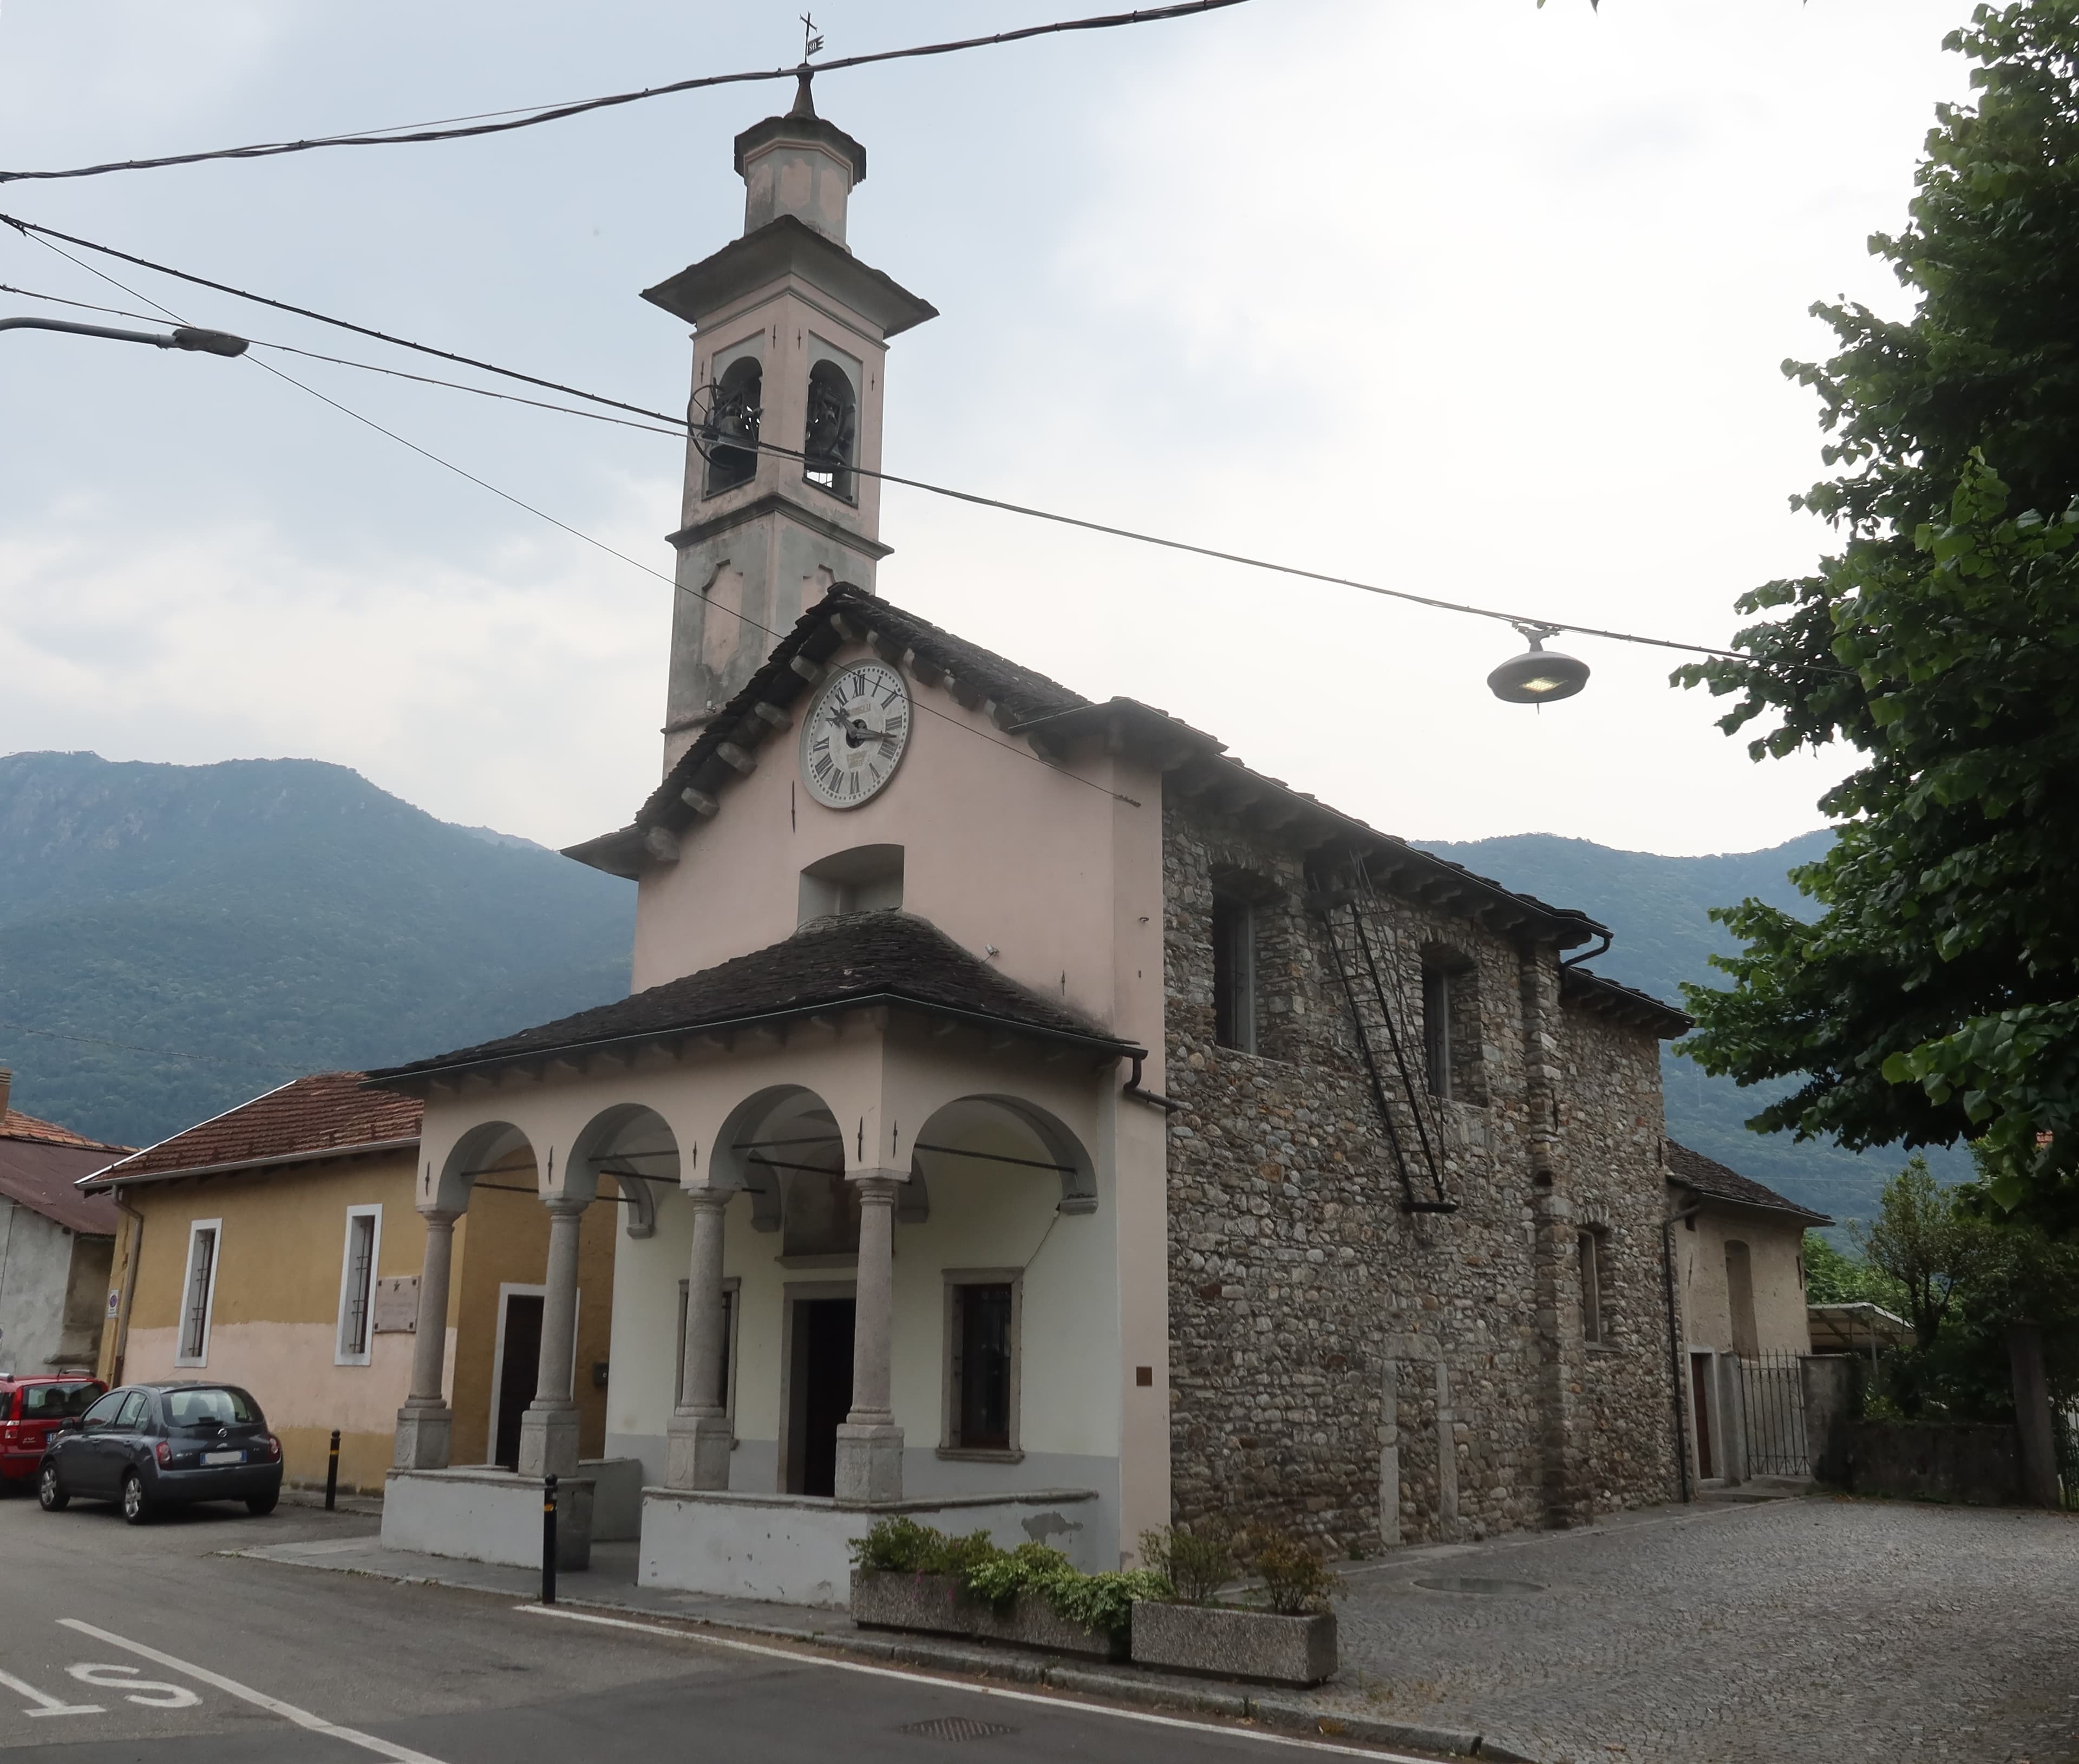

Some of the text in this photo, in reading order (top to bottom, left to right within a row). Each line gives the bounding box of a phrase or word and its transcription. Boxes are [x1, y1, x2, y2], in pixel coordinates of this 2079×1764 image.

[835, 685, 849, 710] XI
[852, 674, 866, 699] XII
[871, 676, 882, 697] I
[880, 689, 898, 711] II
[885, 714, 903, 732] III
[813, 736, 829, 754] IX
[814, 751, 834, 781] VIII
[869, 762, 880, 782] V
[828, 767, 845, 794] VII
[849, 772, 860, 795] VI
